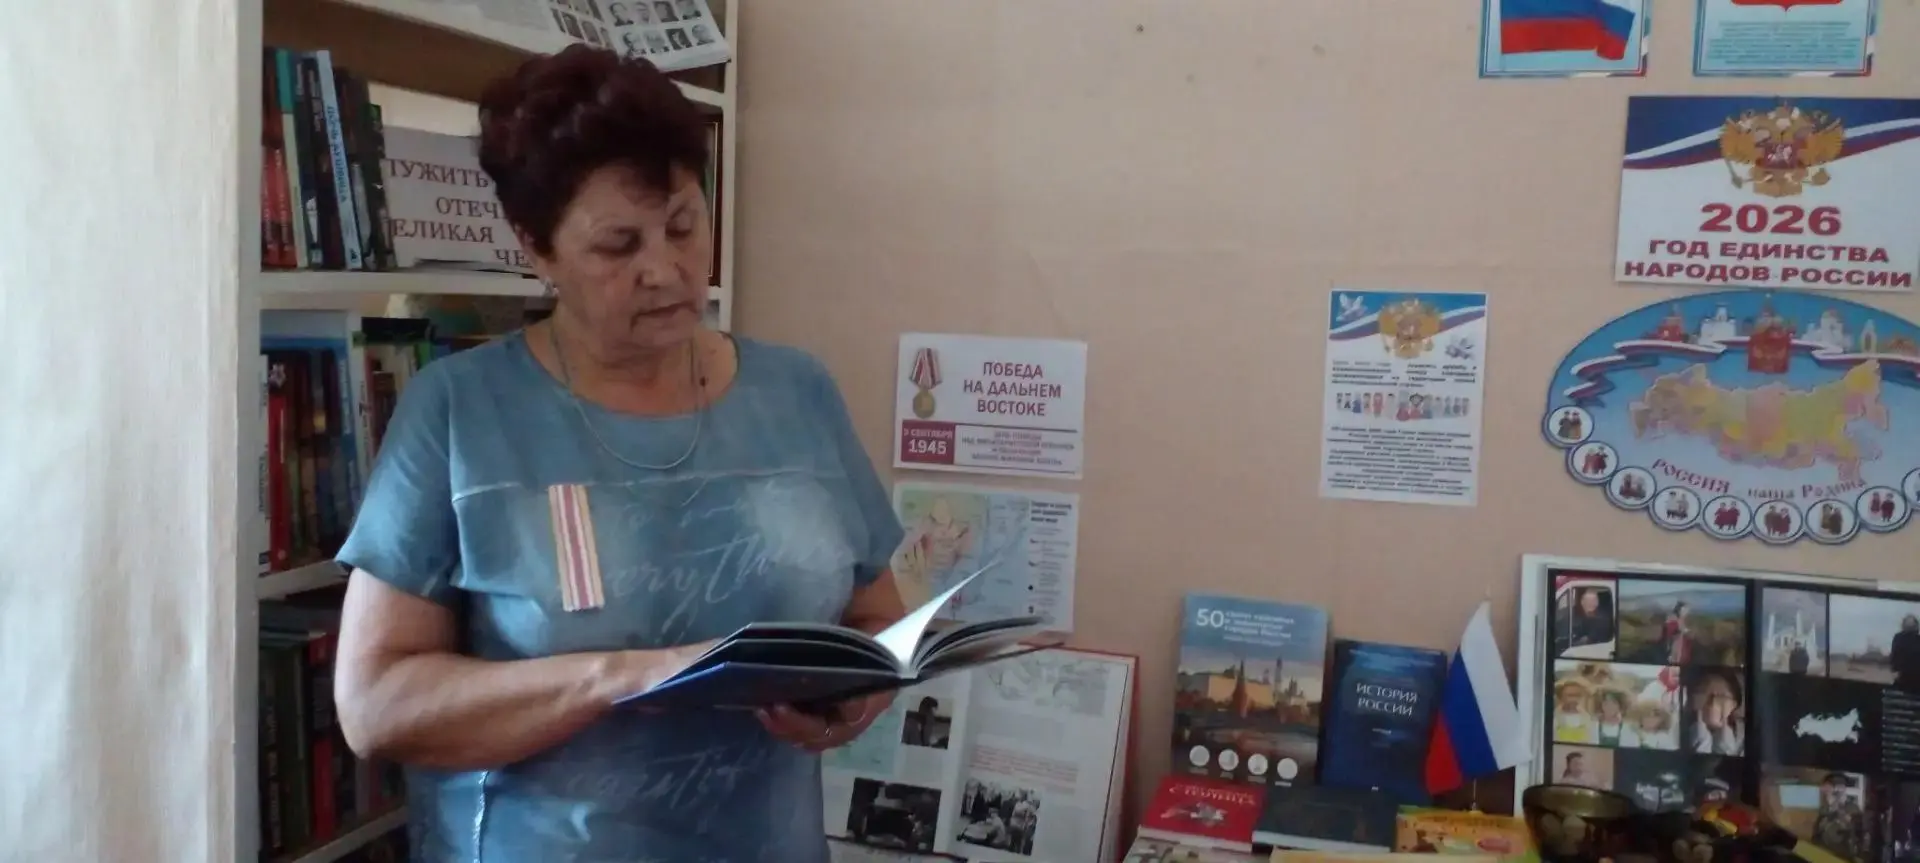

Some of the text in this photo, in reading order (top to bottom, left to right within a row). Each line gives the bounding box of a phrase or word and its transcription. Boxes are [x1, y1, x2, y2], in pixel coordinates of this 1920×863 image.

[1699, 203, 1842, 235] 2026
[1649, 240, 1890, 262] ГОД ЕДИНСТВА
[1624, 262, 1912, 288] НАРОДОВ РОССИИ
[983, 362, 1043, 379] ПОБЕДА
[963, 380, 1062, 399] НА ДАЛЬНЕМ
[977, 400, 1046, 416] ВОСТОКЕ
[908, 439, 948, 455] 1945
[1196, 608, 1224, 628] 50
[1356, 682, 1418, 703] ИСТОРИЯ
[1358, 697, 1413, 716] РОССИИ
